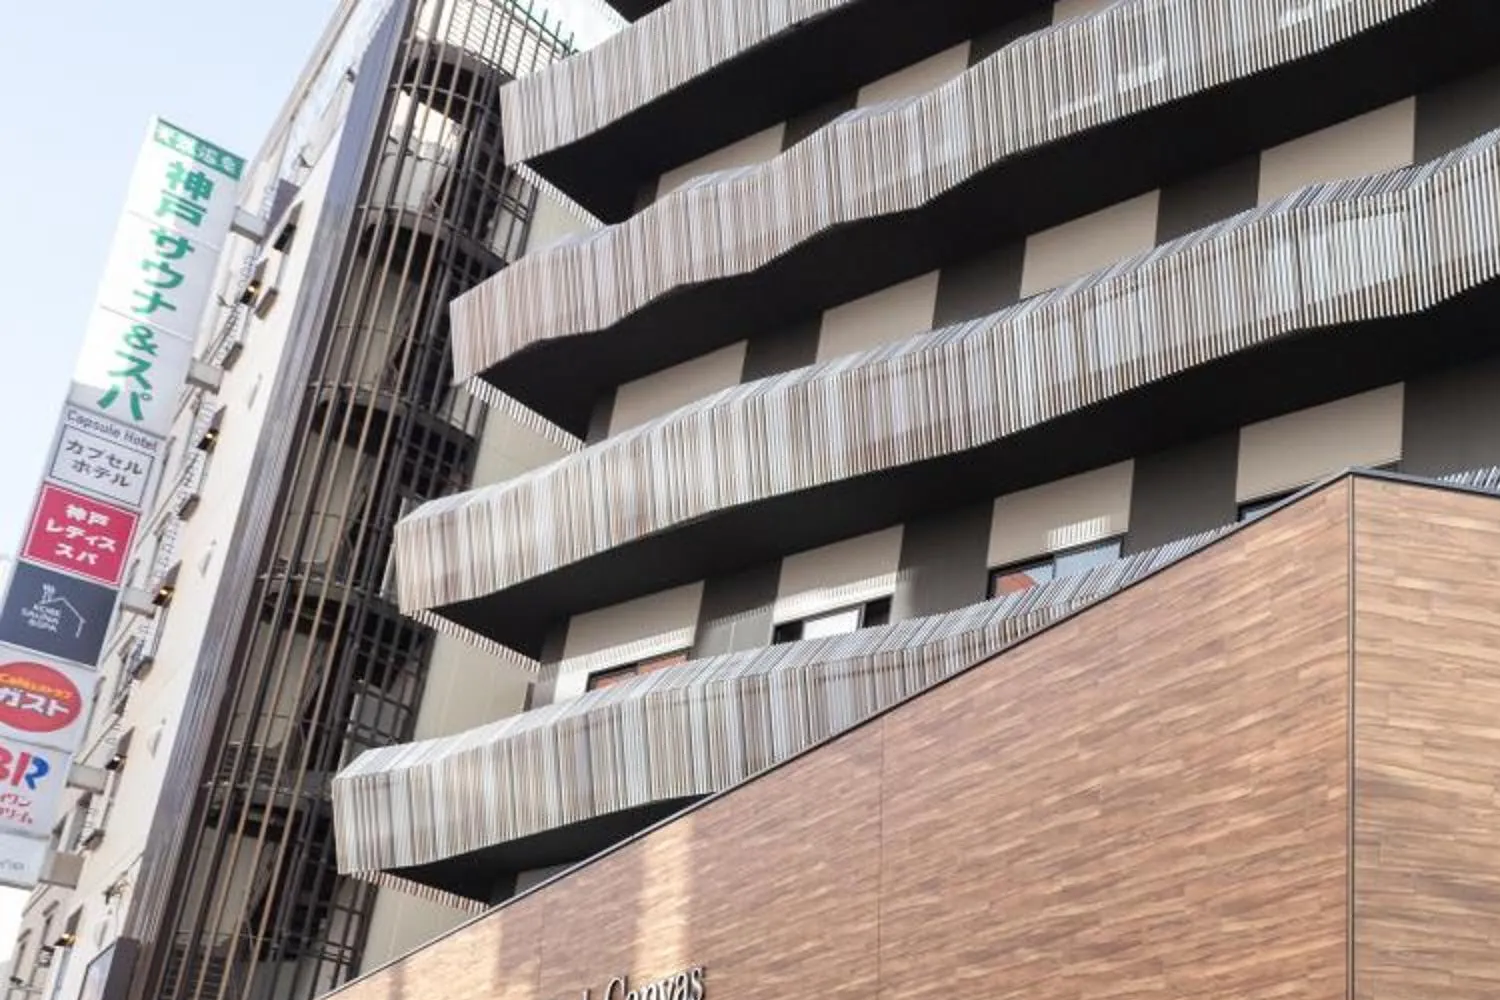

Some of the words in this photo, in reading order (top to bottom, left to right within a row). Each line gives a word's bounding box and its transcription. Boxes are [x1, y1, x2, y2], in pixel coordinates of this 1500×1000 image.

[66, 409, 121, 438] Capsule
[123, 430, 158, 453] Hotel
[65, 440, 143, 475] カプセル
[71, 459, 130, 487] ホテル
